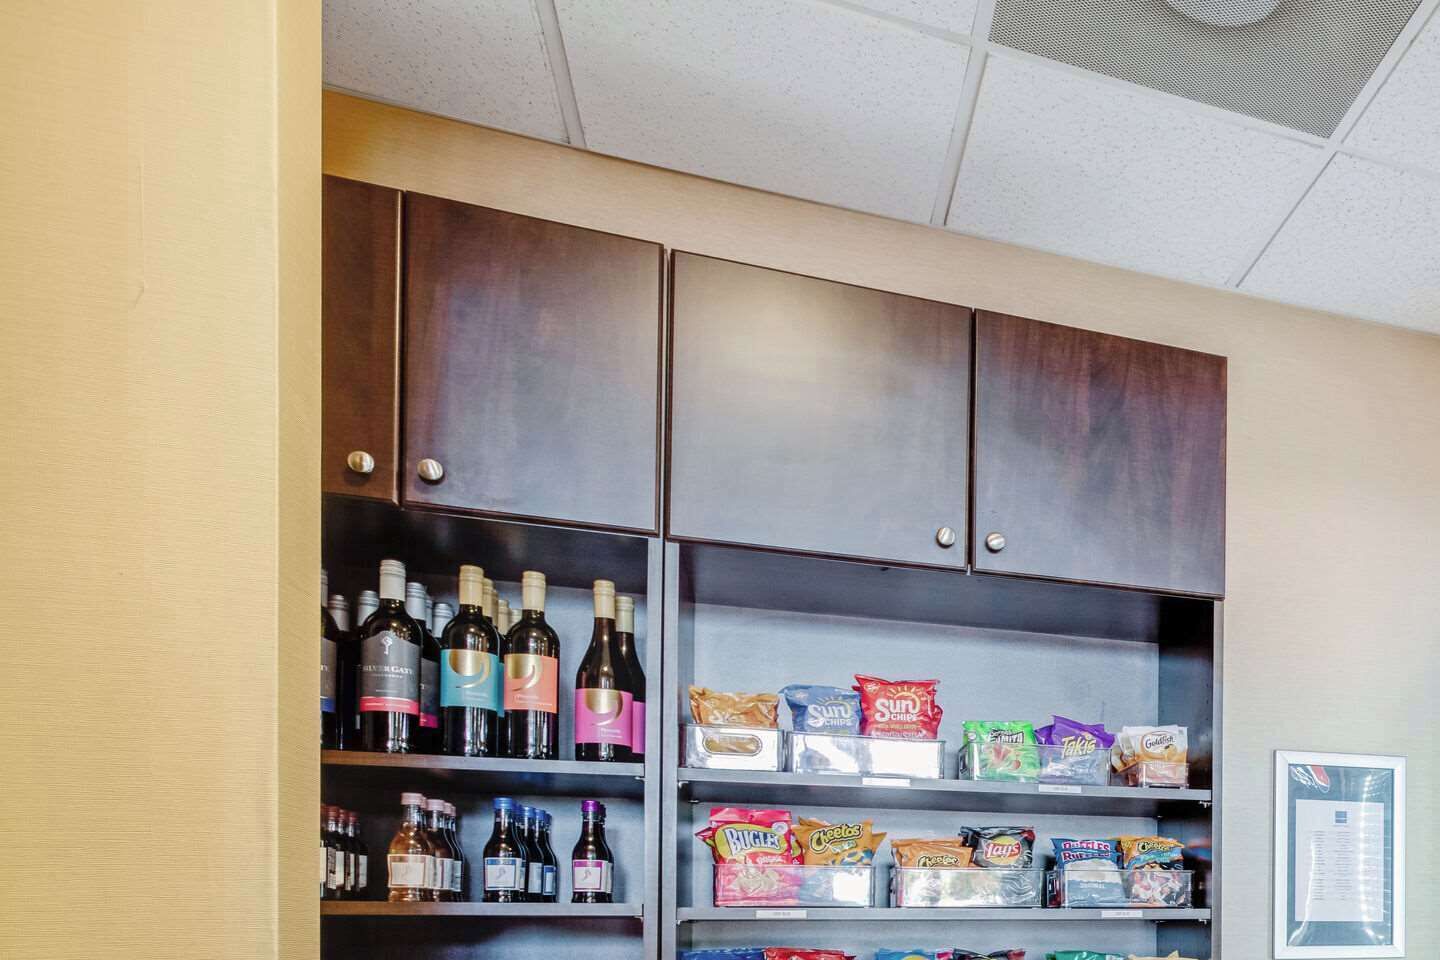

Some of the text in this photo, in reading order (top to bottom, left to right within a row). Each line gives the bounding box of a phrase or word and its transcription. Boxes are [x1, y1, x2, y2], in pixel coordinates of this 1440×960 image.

[807, 704, 850, 726] Sun
[875, 698, 915, 722] Sun
[1062, 736, 1096, 760] Takis
[1145, 733, 1177, 750] Goldfish
[809, 823, 863, 854] Cheetos
